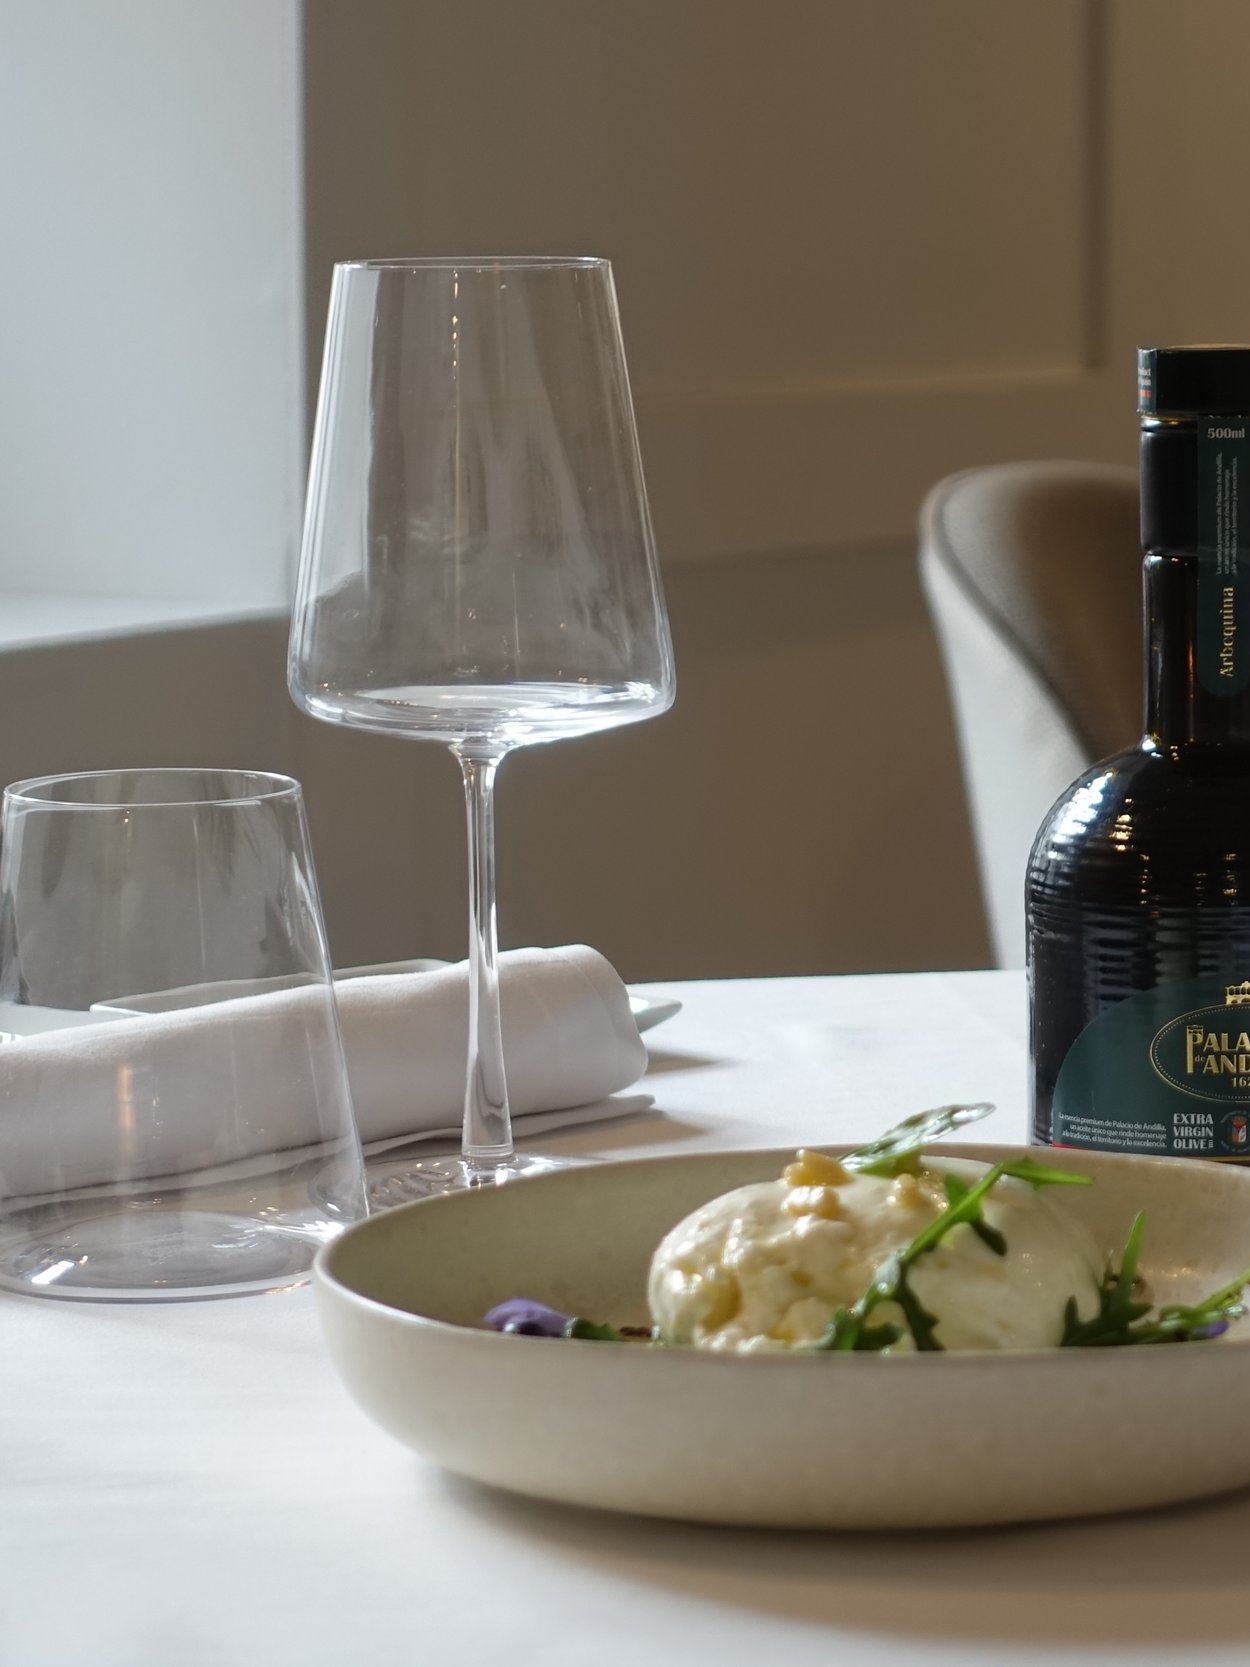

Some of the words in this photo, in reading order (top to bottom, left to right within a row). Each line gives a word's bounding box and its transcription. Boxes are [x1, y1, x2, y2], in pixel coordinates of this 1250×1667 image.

[1207, 427, 1245, 439] 500ml
[1215, 485, 1223, 506] Palacio
[1215, 515, 1223, 544] premium
[1220, 587, 1236, 677] Arbequina
[1081, 1117, 1105, 1125] premium
[1105, 1119, 1112, 1127] de
[1112, 1120, 1133, 1129] Palacio
[1173, 1112, 1214, 1125] EXTRA
[1107, 1129, 1118, 1137] que
[1119, 1129, 1134, 1138] rinde
[1135, 1130, 1167, 1140] homenaje
[1173, 1126, 1214, 1137] VIRGIN
[1173, 1138, 1208, 1149] OLIVE
